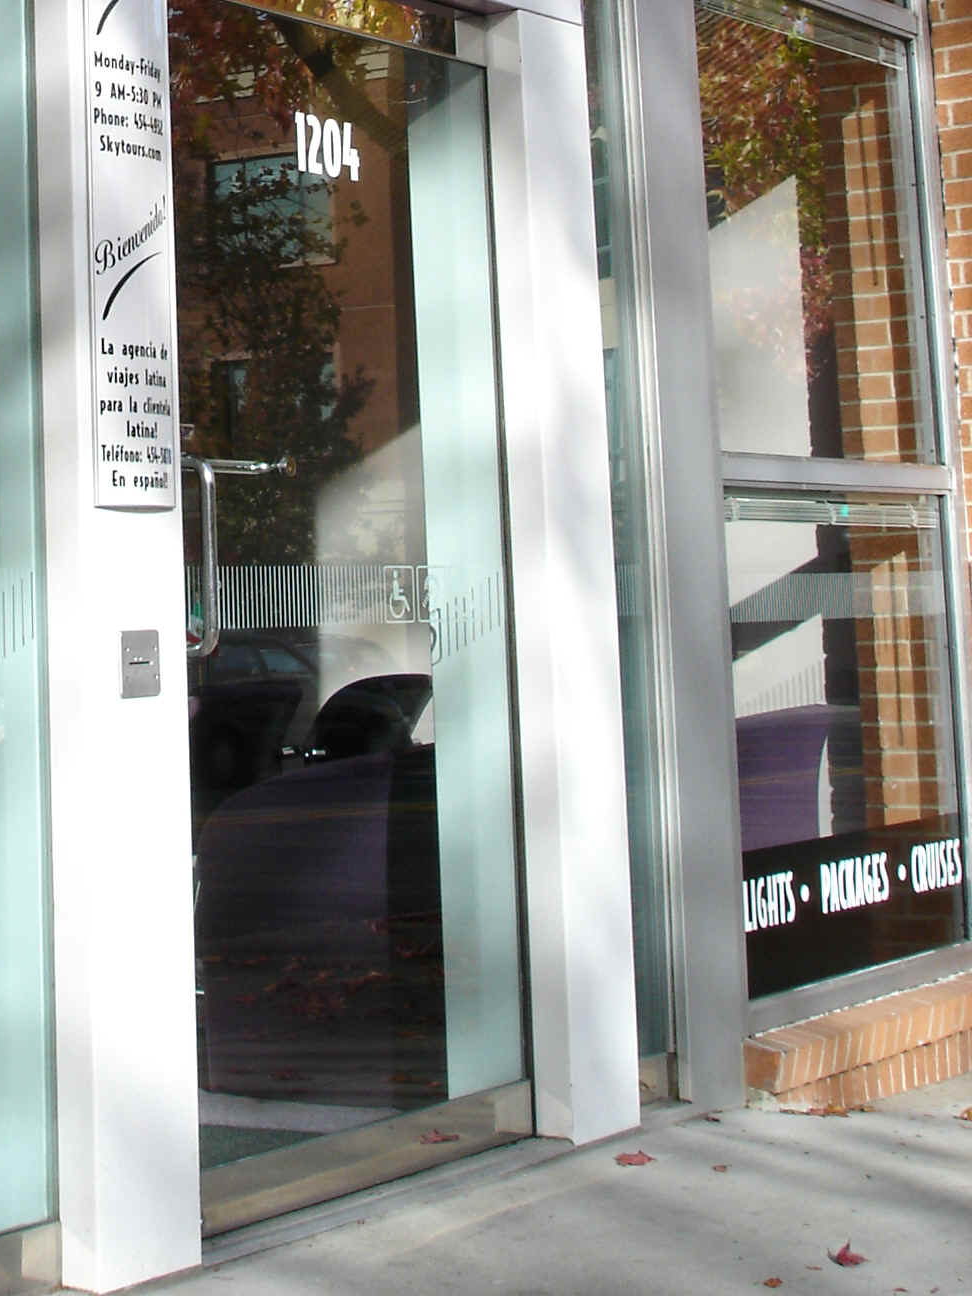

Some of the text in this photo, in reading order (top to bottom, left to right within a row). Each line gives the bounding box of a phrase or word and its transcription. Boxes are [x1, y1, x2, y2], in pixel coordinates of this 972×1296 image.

[94, 51, 161, 83] Monday-Friday
[95, 80, 102, 98] 9
[153, 92, 162, 109] PM
[93, 108, 129, 128] Phone:
[99, 135, 162, 161] Skytours.com
[294, 111, 360, 182] 1204
[94, 195, 166, 275] Bienvenido!
[101, 338, 168, 360] La agencia de
[107, 367, 167, 388] viajes latina
[100, 399, 123, 415] para
[129, 396, 138, 413] la
[126, 421, 158, 439] latina!
[101, 444, 143, 463] Teléfono:
[112, 470, 126, 487] En
[819, 851, 890, 914] PACKAGES
[910, 838, 963, 893] CRUISES
